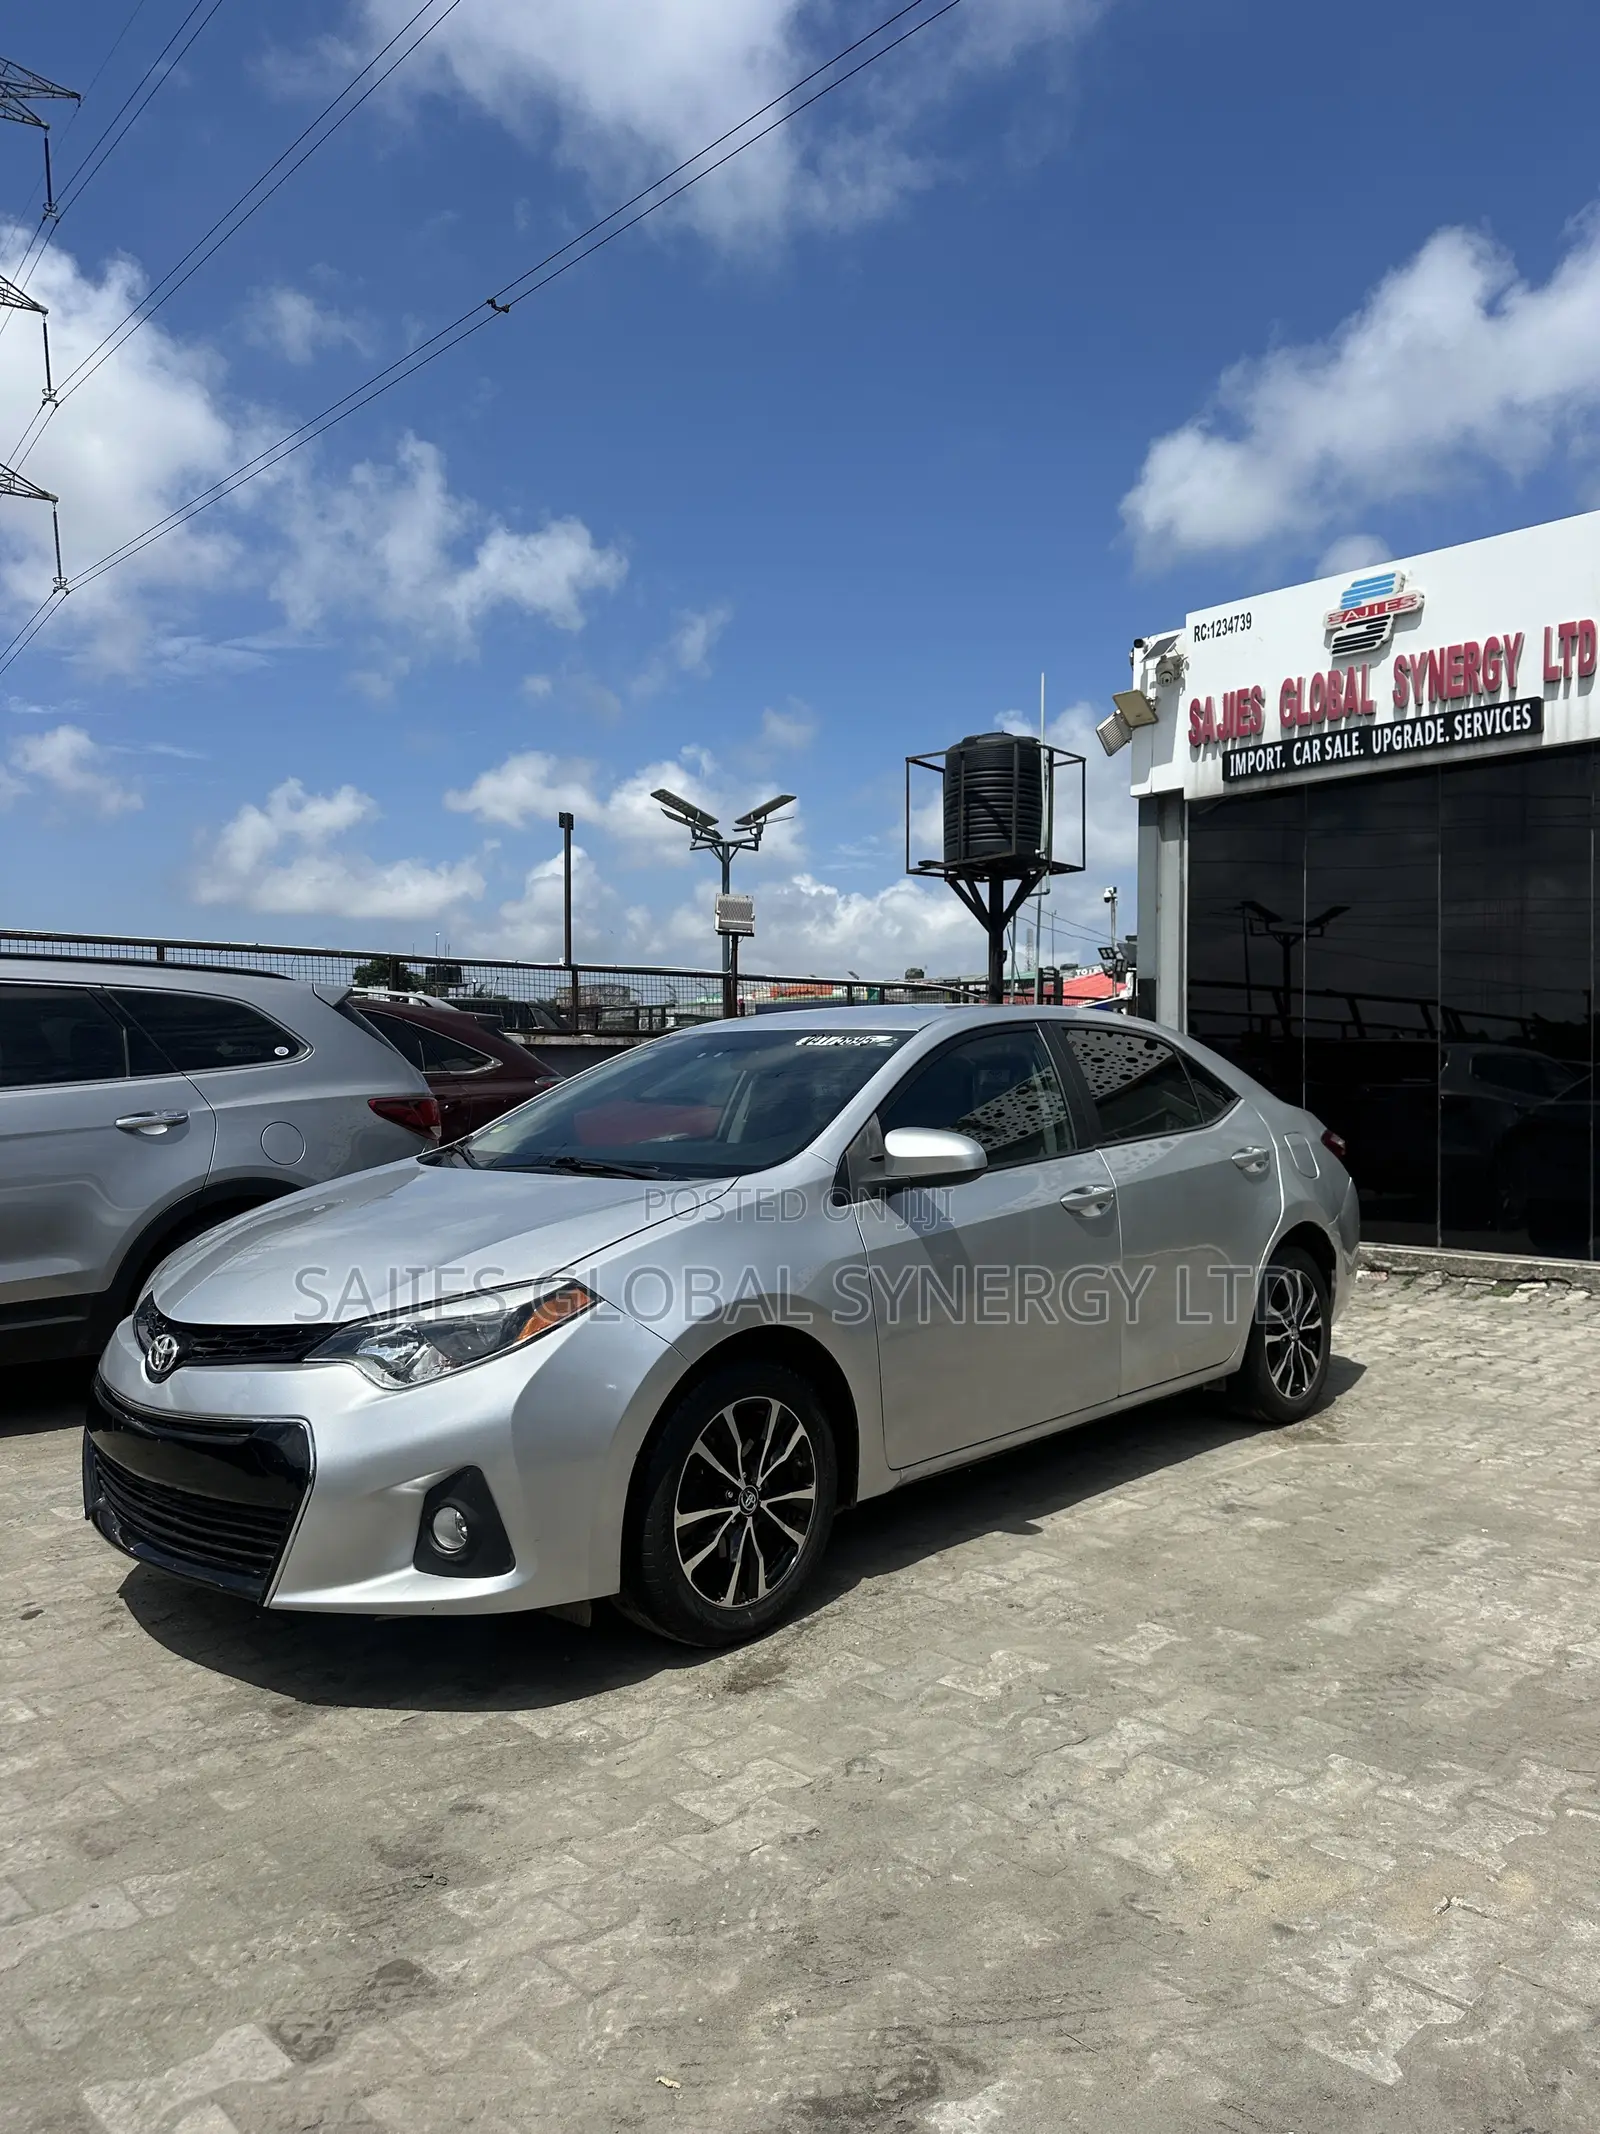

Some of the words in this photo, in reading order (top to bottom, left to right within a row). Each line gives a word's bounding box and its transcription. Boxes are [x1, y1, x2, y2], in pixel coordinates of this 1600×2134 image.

[1193, 612, 1252, 642] RC:1234739
[1326, 593, 1419, 625] SAJIES
[1188, 685, 1265, 748] SAJIES
[1279, 663, 1377, 729] GLOBAL
[1392, 631, 1526, 709] SYNERGY
[1542, 618, 1598, 683] LTD
[1229, 745, 1286, 777] IMPORT.
[1292, 739, 1322, 766] CAR
[1324, 730, 1365, 761] SALE.
[1371, 716, 1450, 755] UPGRADE.
[1453, 702, 1533, 742] SERVICES
